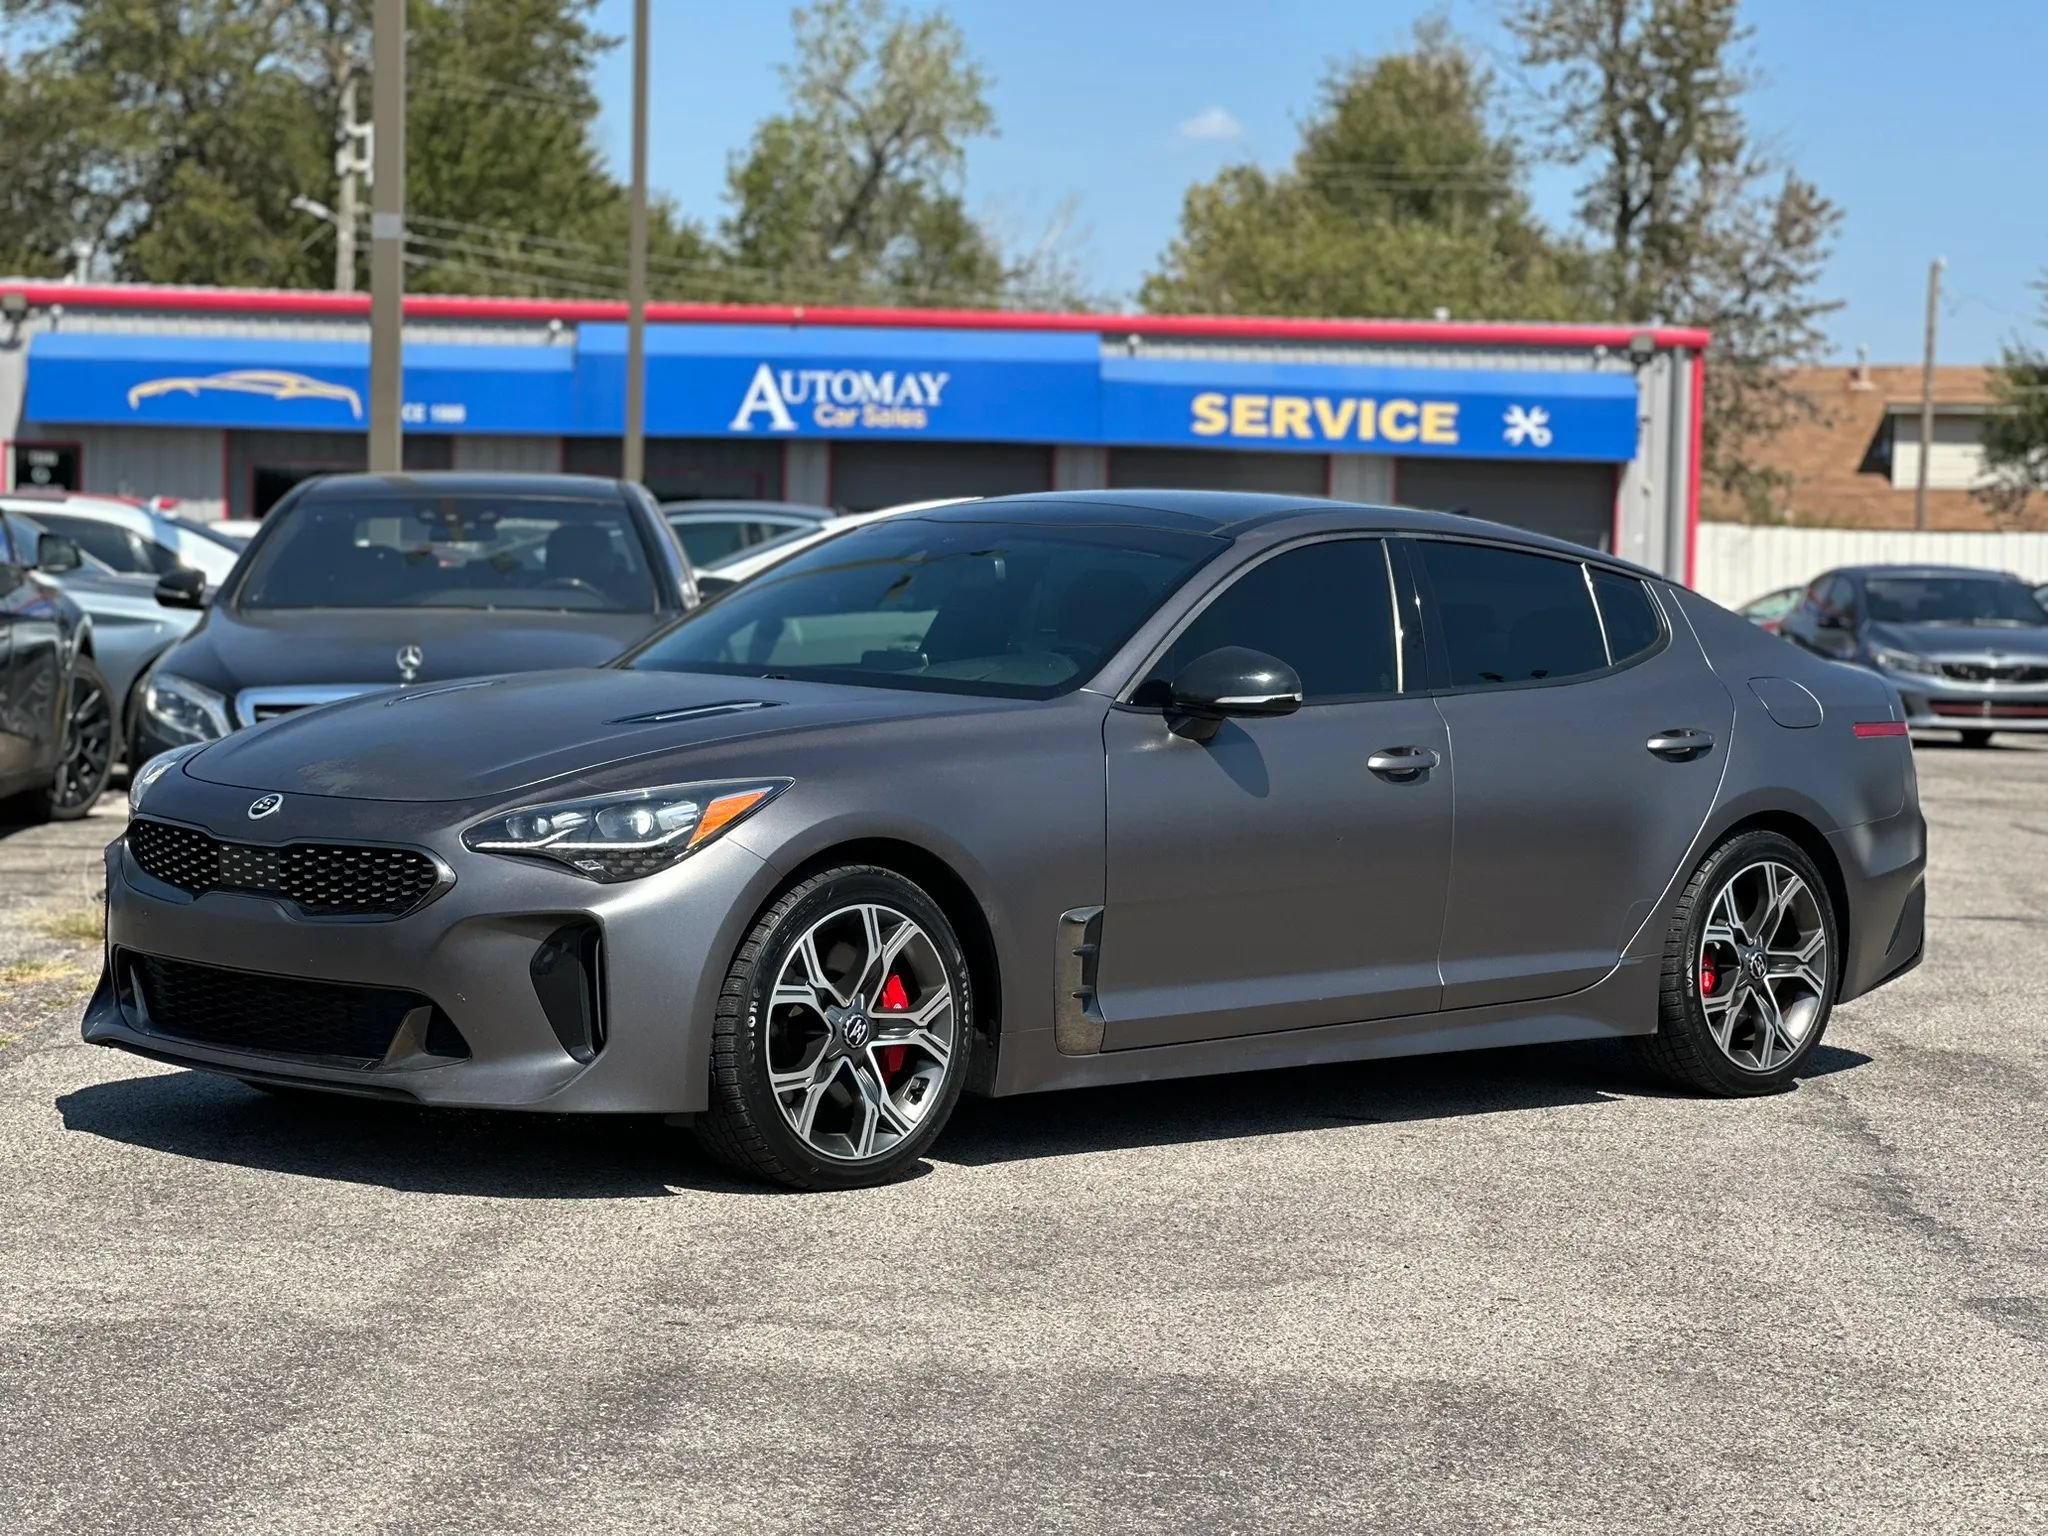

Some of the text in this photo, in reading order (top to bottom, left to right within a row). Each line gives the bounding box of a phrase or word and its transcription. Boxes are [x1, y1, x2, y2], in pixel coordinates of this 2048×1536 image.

[729, 362, 949, 431] AUTOMAY
[813, 401, 928, 429] Car Sales
[1191, 393, 1459, 444] SERVICE
